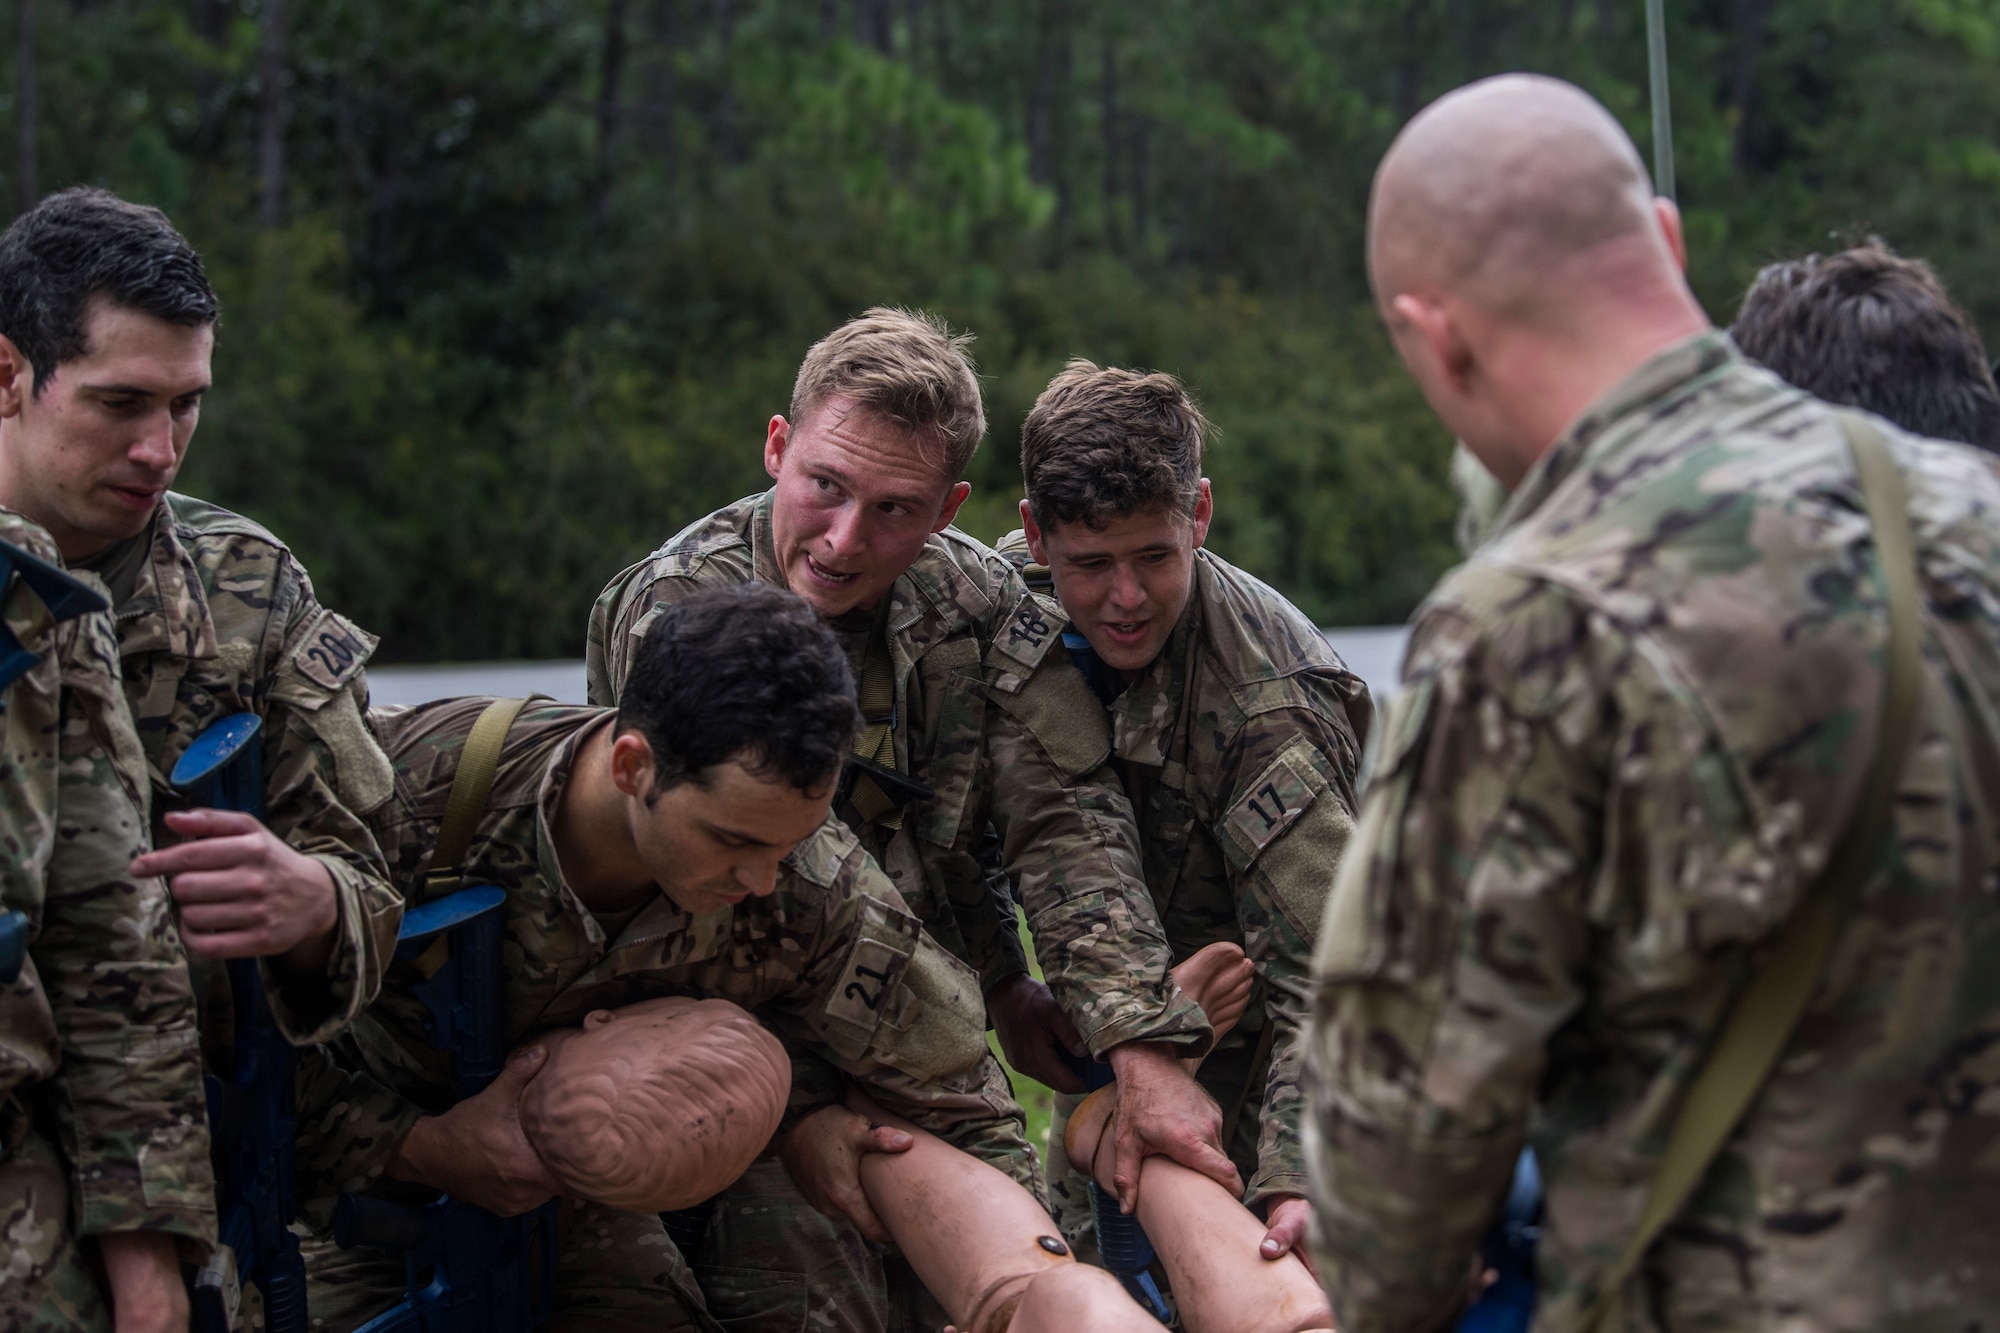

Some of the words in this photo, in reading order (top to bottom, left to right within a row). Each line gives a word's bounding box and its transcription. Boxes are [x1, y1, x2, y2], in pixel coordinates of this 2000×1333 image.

[1009, 612, 1050, 648] 16
[307, 632, 354, 677] 20
[1248, 782, 1287, 830] 17
[845, 965, 891, 1010] 21
